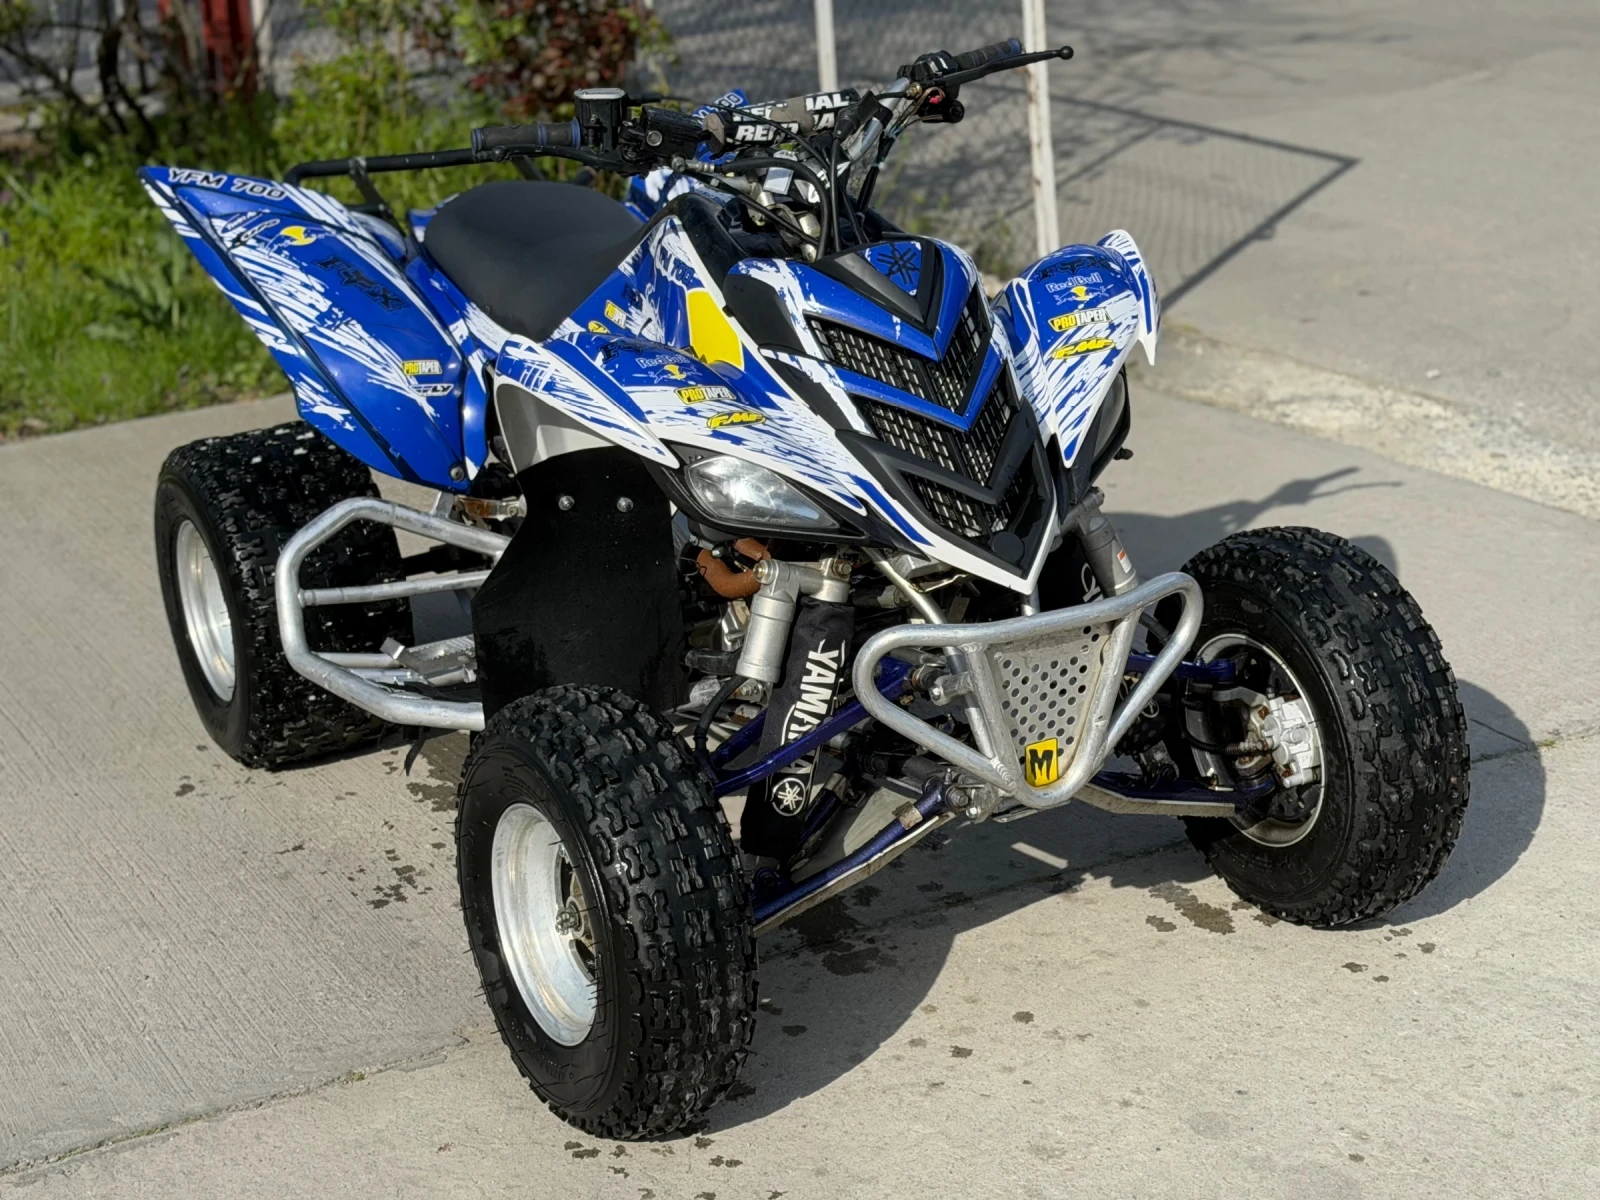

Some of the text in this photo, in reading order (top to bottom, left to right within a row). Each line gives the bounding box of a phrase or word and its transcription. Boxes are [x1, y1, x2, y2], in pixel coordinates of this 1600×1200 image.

[168, 168, 287, 201] YFM 700
[1054, 308, 1107, 330] PROTAPER
[404, 361, 440, 375] PROTAPER
[681, 386, 734, 402] PROTAPER
[709, 411, 763, 428] FMF
[1029, 749, 1054, 781] M
